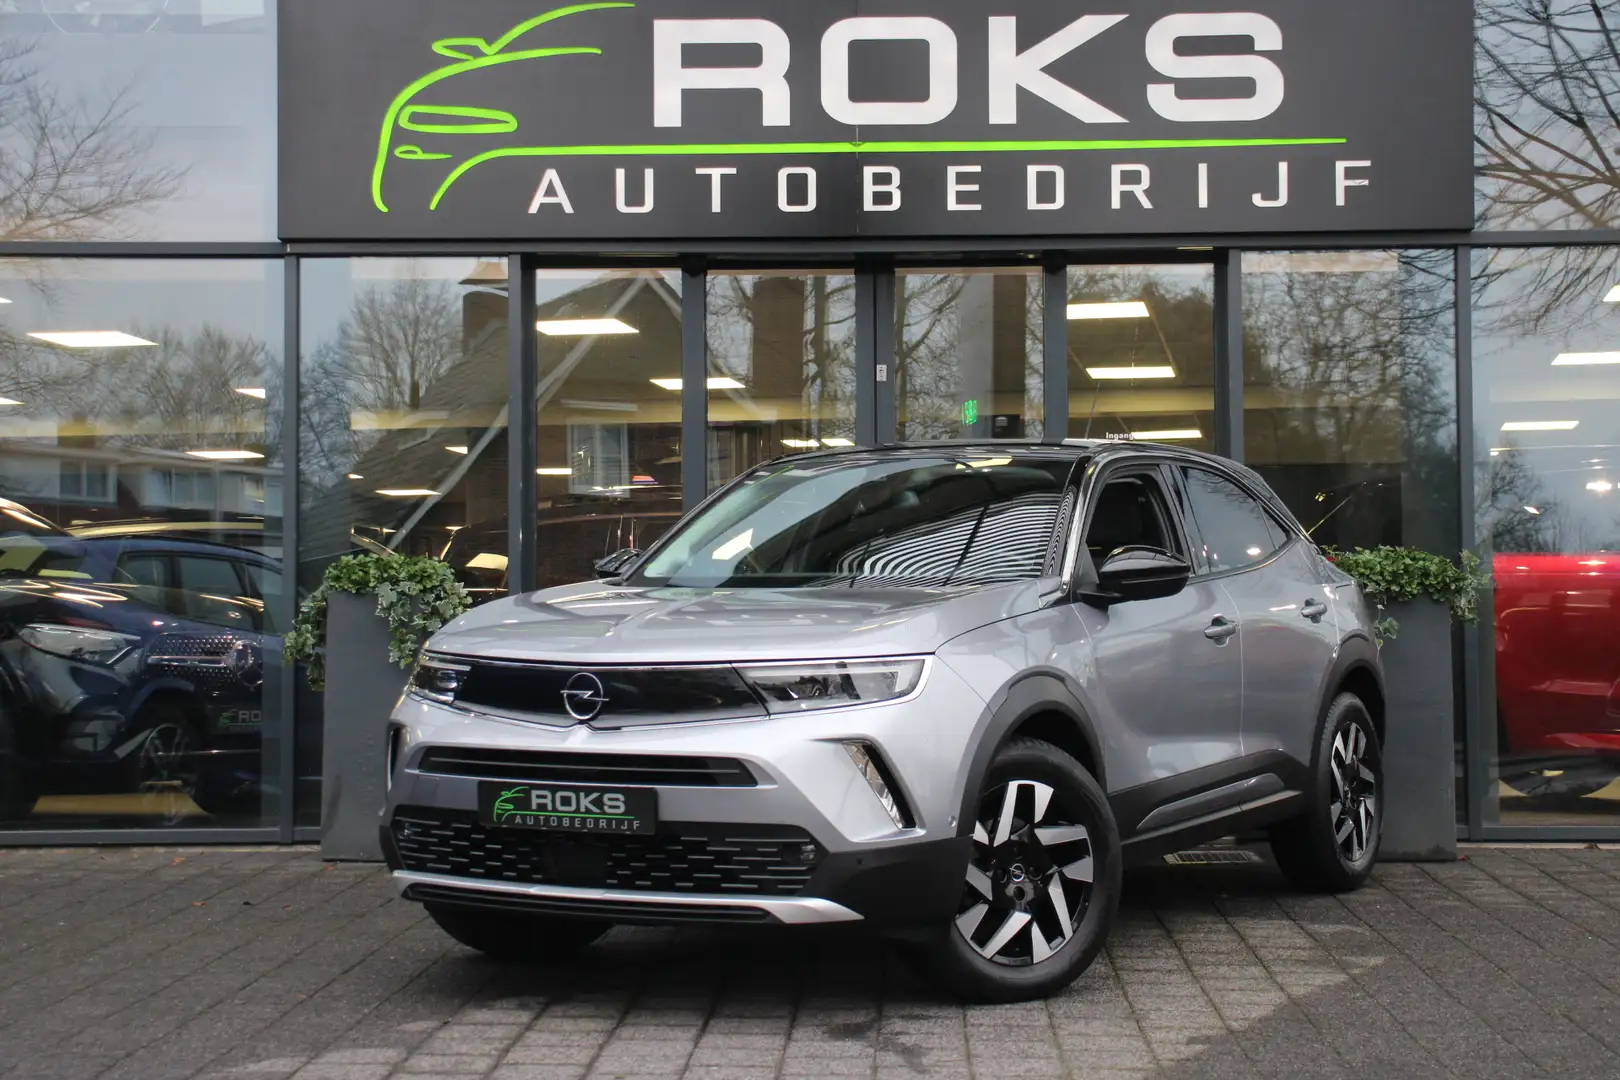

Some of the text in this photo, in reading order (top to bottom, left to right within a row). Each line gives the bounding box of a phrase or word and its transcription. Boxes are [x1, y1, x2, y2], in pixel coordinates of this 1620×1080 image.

[653, 12, 1284, 128] ROKS
[528, 160, 1371, 214] AUTOBEDRIJF
[1105, 431, 1134, 441] Ingang
[530, 789, 626, 814] ROKS
[514, 815, 640, 831] AUTOBEDRIJF
